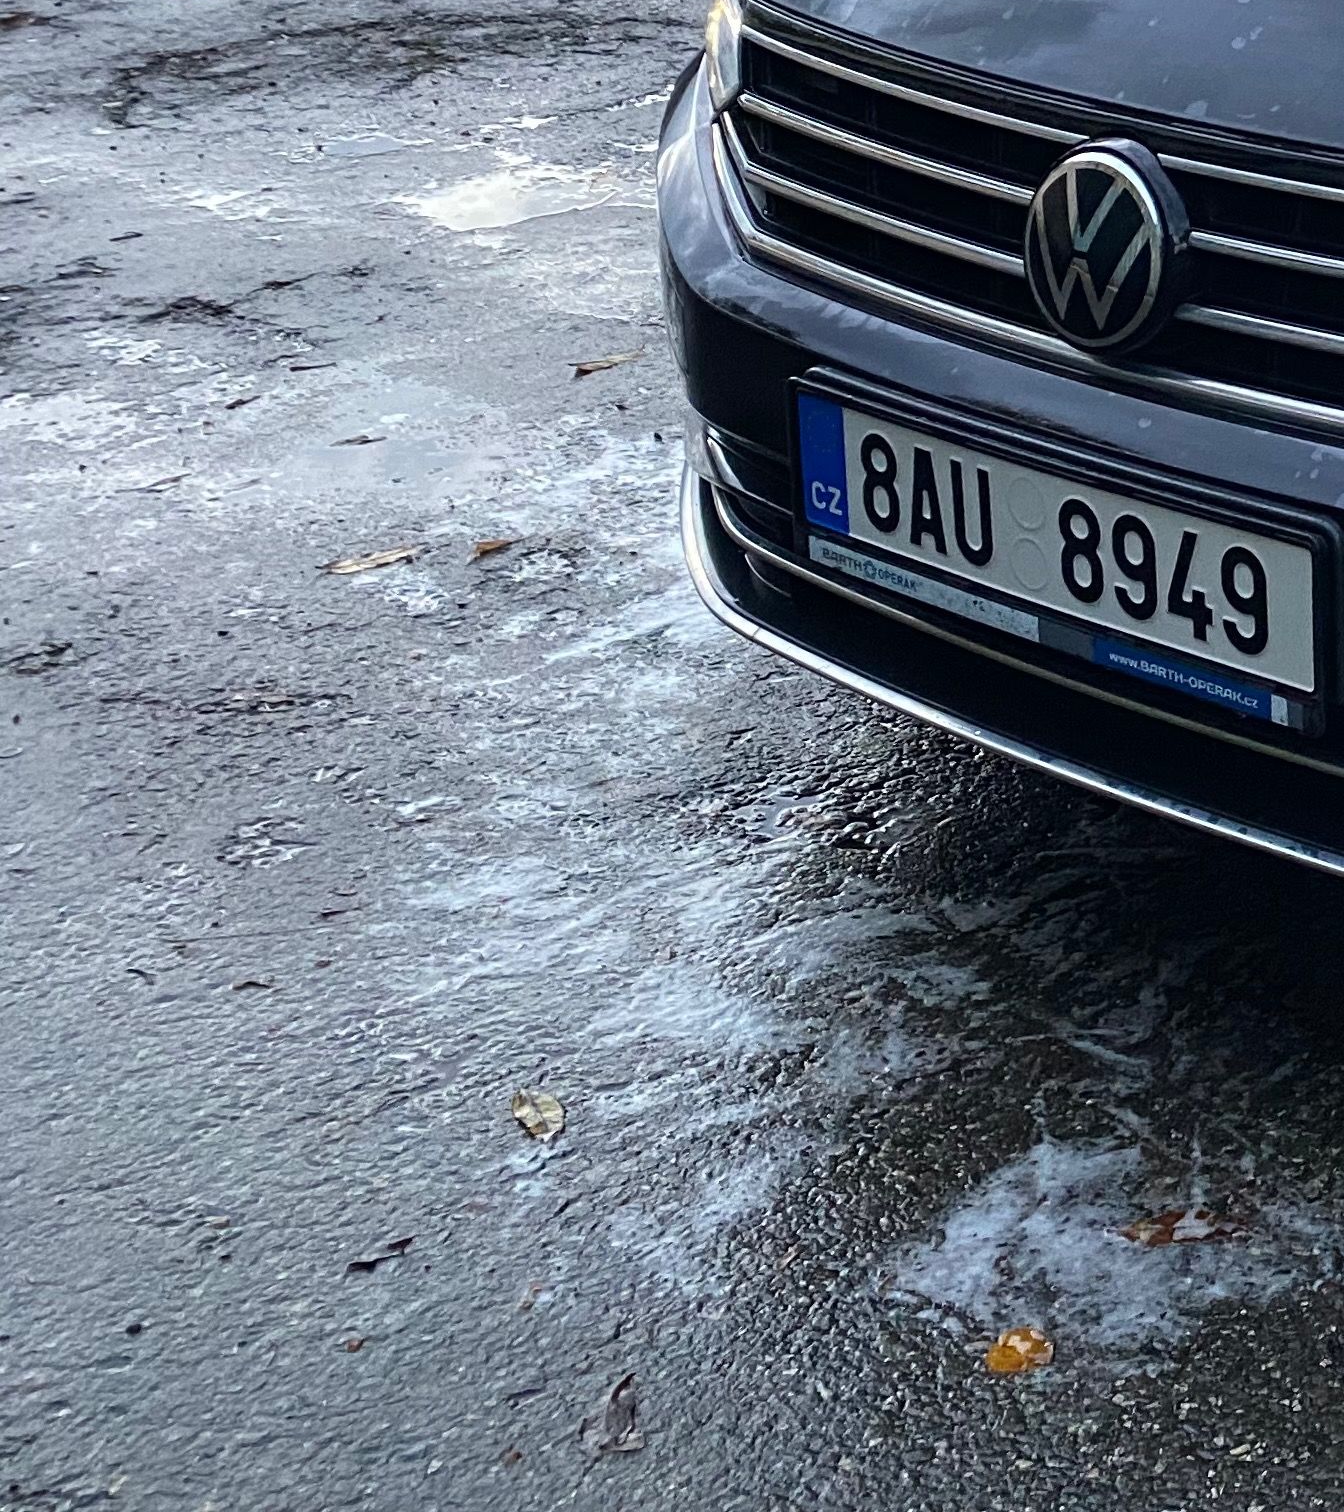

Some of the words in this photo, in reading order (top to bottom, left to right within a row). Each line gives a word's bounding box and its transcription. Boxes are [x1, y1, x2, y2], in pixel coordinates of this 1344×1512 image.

[1032, 163, 1154, 334] VW
[811, 481, 843, 516] CZ
[861, 433, 993, 567] 8AU
[1058, 498, 1269, 656] 8949
[1108, 652, 1259, 710] www.BARTH-OPERAK.cz
